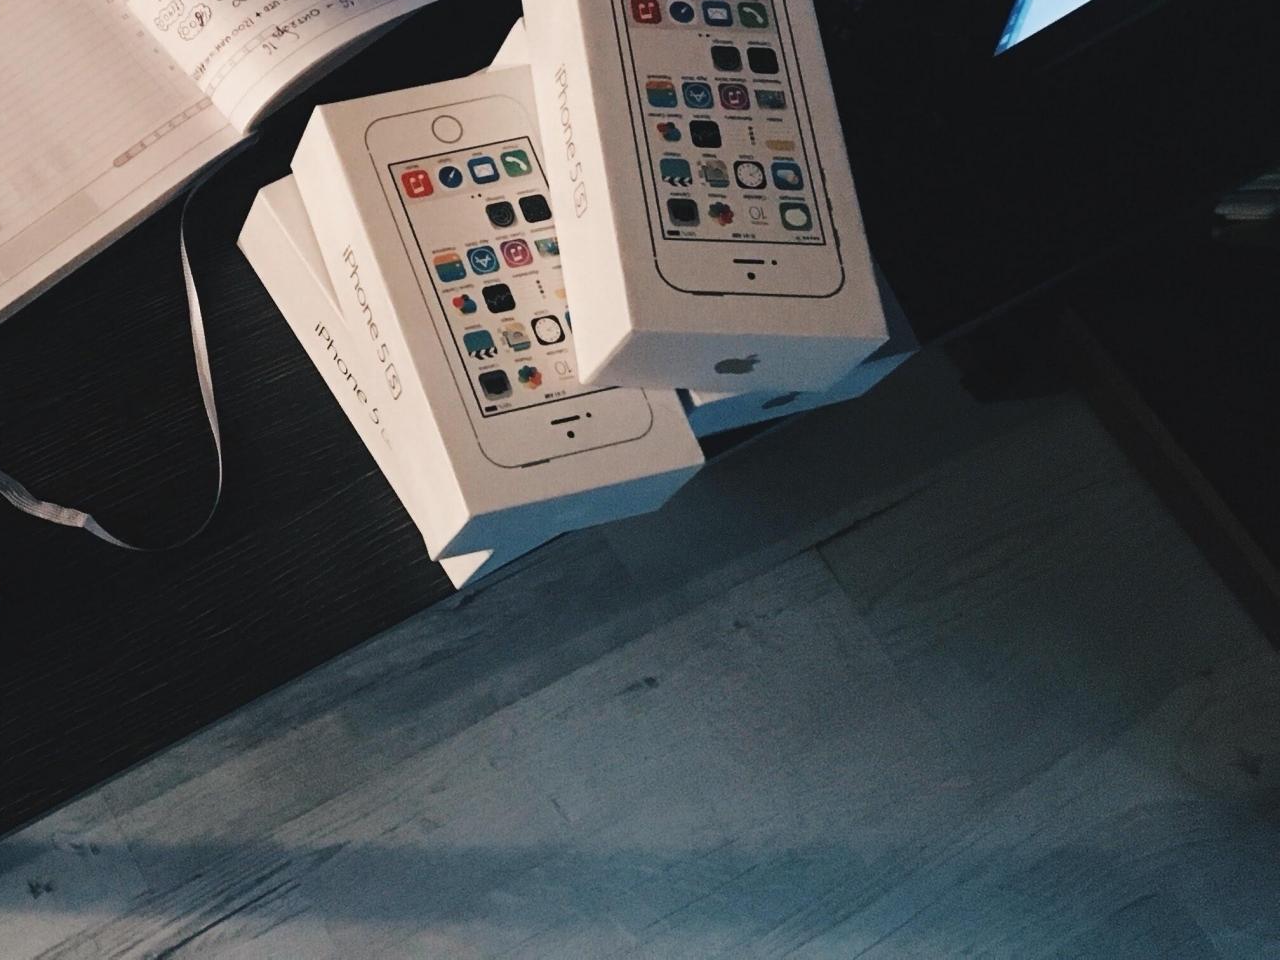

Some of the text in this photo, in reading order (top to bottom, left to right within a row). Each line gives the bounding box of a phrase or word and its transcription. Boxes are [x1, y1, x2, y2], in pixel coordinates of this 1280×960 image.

[554, 63, 575, 160] iPhone
[341, 245, 380, 340] iPhone
[314, 322, 371, 404] iPhone
